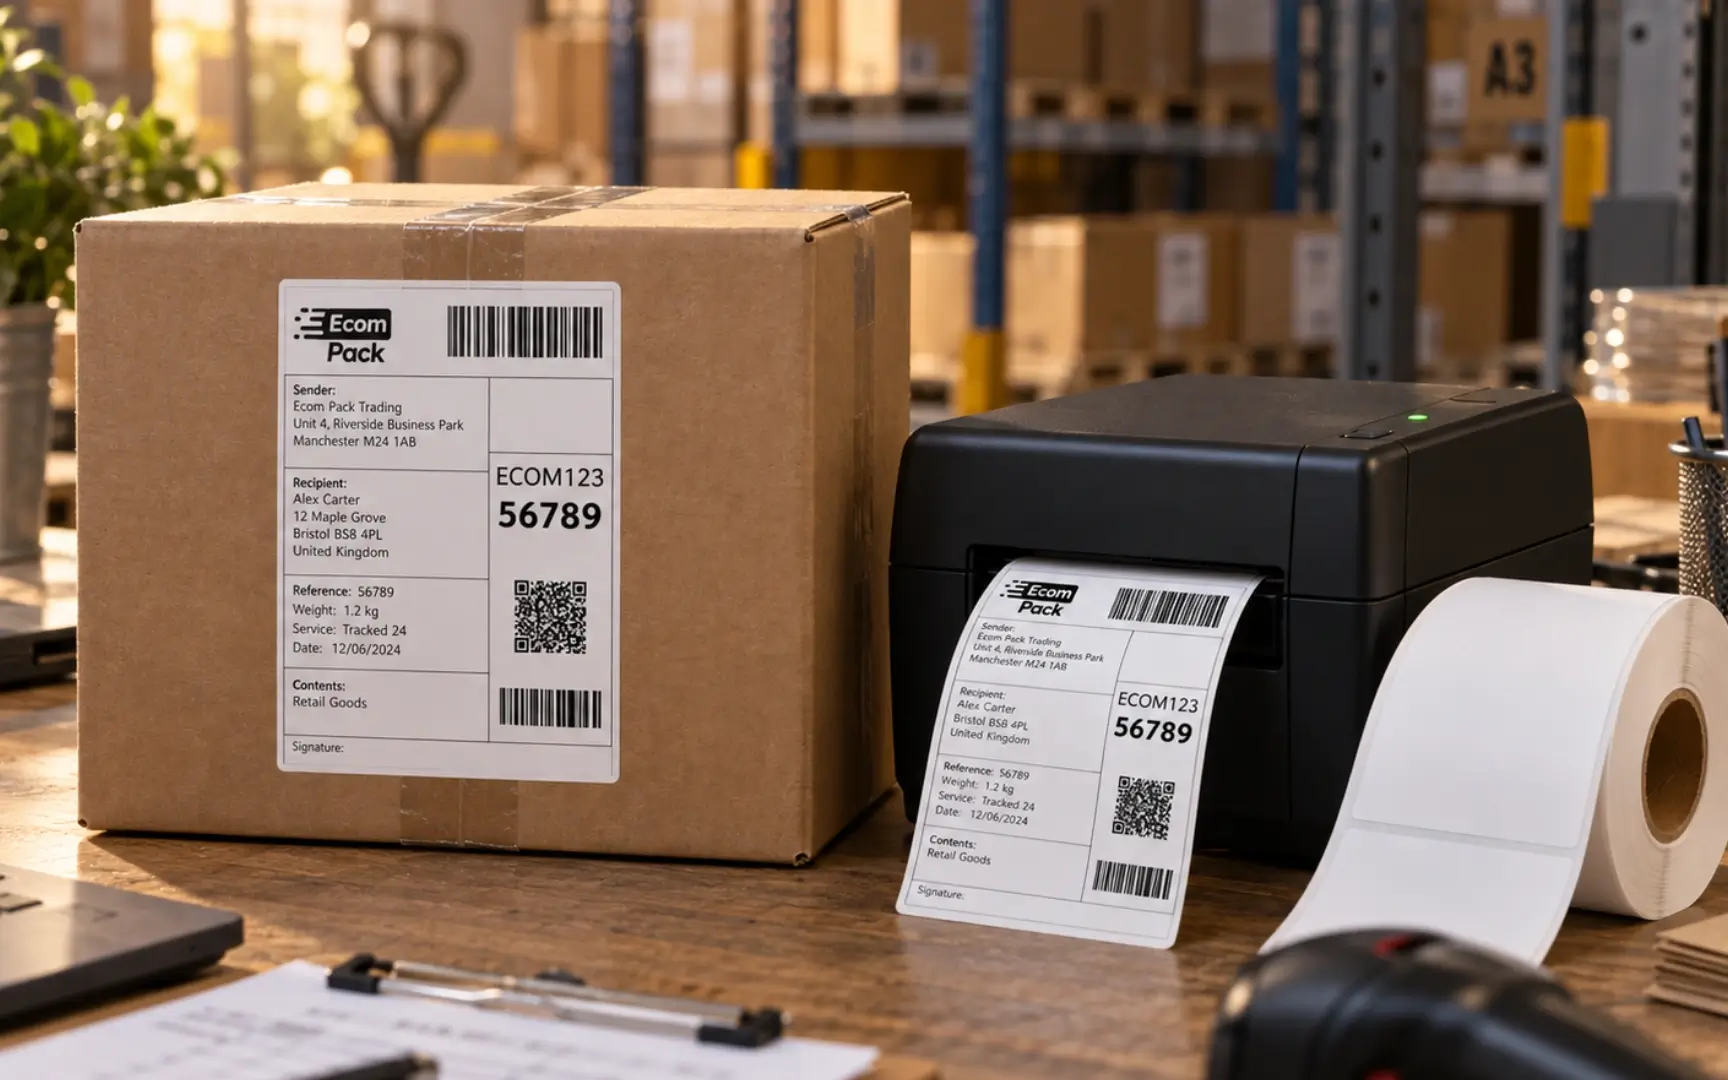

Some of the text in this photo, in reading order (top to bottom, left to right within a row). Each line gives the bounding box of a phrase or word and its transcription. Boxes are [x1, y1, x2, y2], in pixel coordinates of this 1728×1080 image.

[1485, 41, 1537, 98] A3
[328, 313, 388, 333] Ecom
[327, 342, 386, 363] Pack
[293, 384, 336, 396] Sender:
[293, 400, 402, 416] Ecom Pack Trading
[293, 418, 464, 431] Unit 4, Riverside Business Park
[293, 435, 417, 448] Manchester M24 1AB
[293, 477, 347, 490] Recipient:
[496, 467, 604, 487] ECOM123
[293, 493, 360, 505] Alex Carter
[294, 511, 387, 525] 12 Maple Grove
[498, 501, 602, 530] 56789
[293, 528, 383, 541] Bristol BS8 4PL
[293, 545, 389, 560] United Kingdom
[292, 584, 395, 598] Reference: 56789
[1026, 583, 1073, 600] Ecom
[292, 604, 379, 620] Weight: 1.2 kg
[1017, 601, 1064, 617] Pack
[292, 622, 407, 637] Service: Tracked 24
[292, 641, 401, 656] Date: 12/06/2024
[1024, 659, 1046, 669] M24
[1085, 653, 1104, 663] Park
[292, 679, 346, 691] Contents:
[960, 686, 1006, 700] Recipient:
[292, 696, 368, 709] Retail Goods
[983, 701, 1016, 715] Carter
[1117, 692, 1200, 714] ECOM123
[953, 713, 986, 726] Bristol
[1010, 720, 1028, 731] 4PL
[950, 728, 1031, 746] United Kingdom
[1113, 717, 1193, 744] 56789
[292, 741, 344, 754] Signature:
[943, 761, 1030, 781] Reference: 56789
[942, 776, 1014, 797] Weight: 1.2 kg
[938, 790, 1035, 812] Service: Tracked 24
[935, 804, 1029, 826] Date: 12/06/2024
[929, 834, 977, 850] Contents:
[927, 847, 992, 866] Retail Goods
